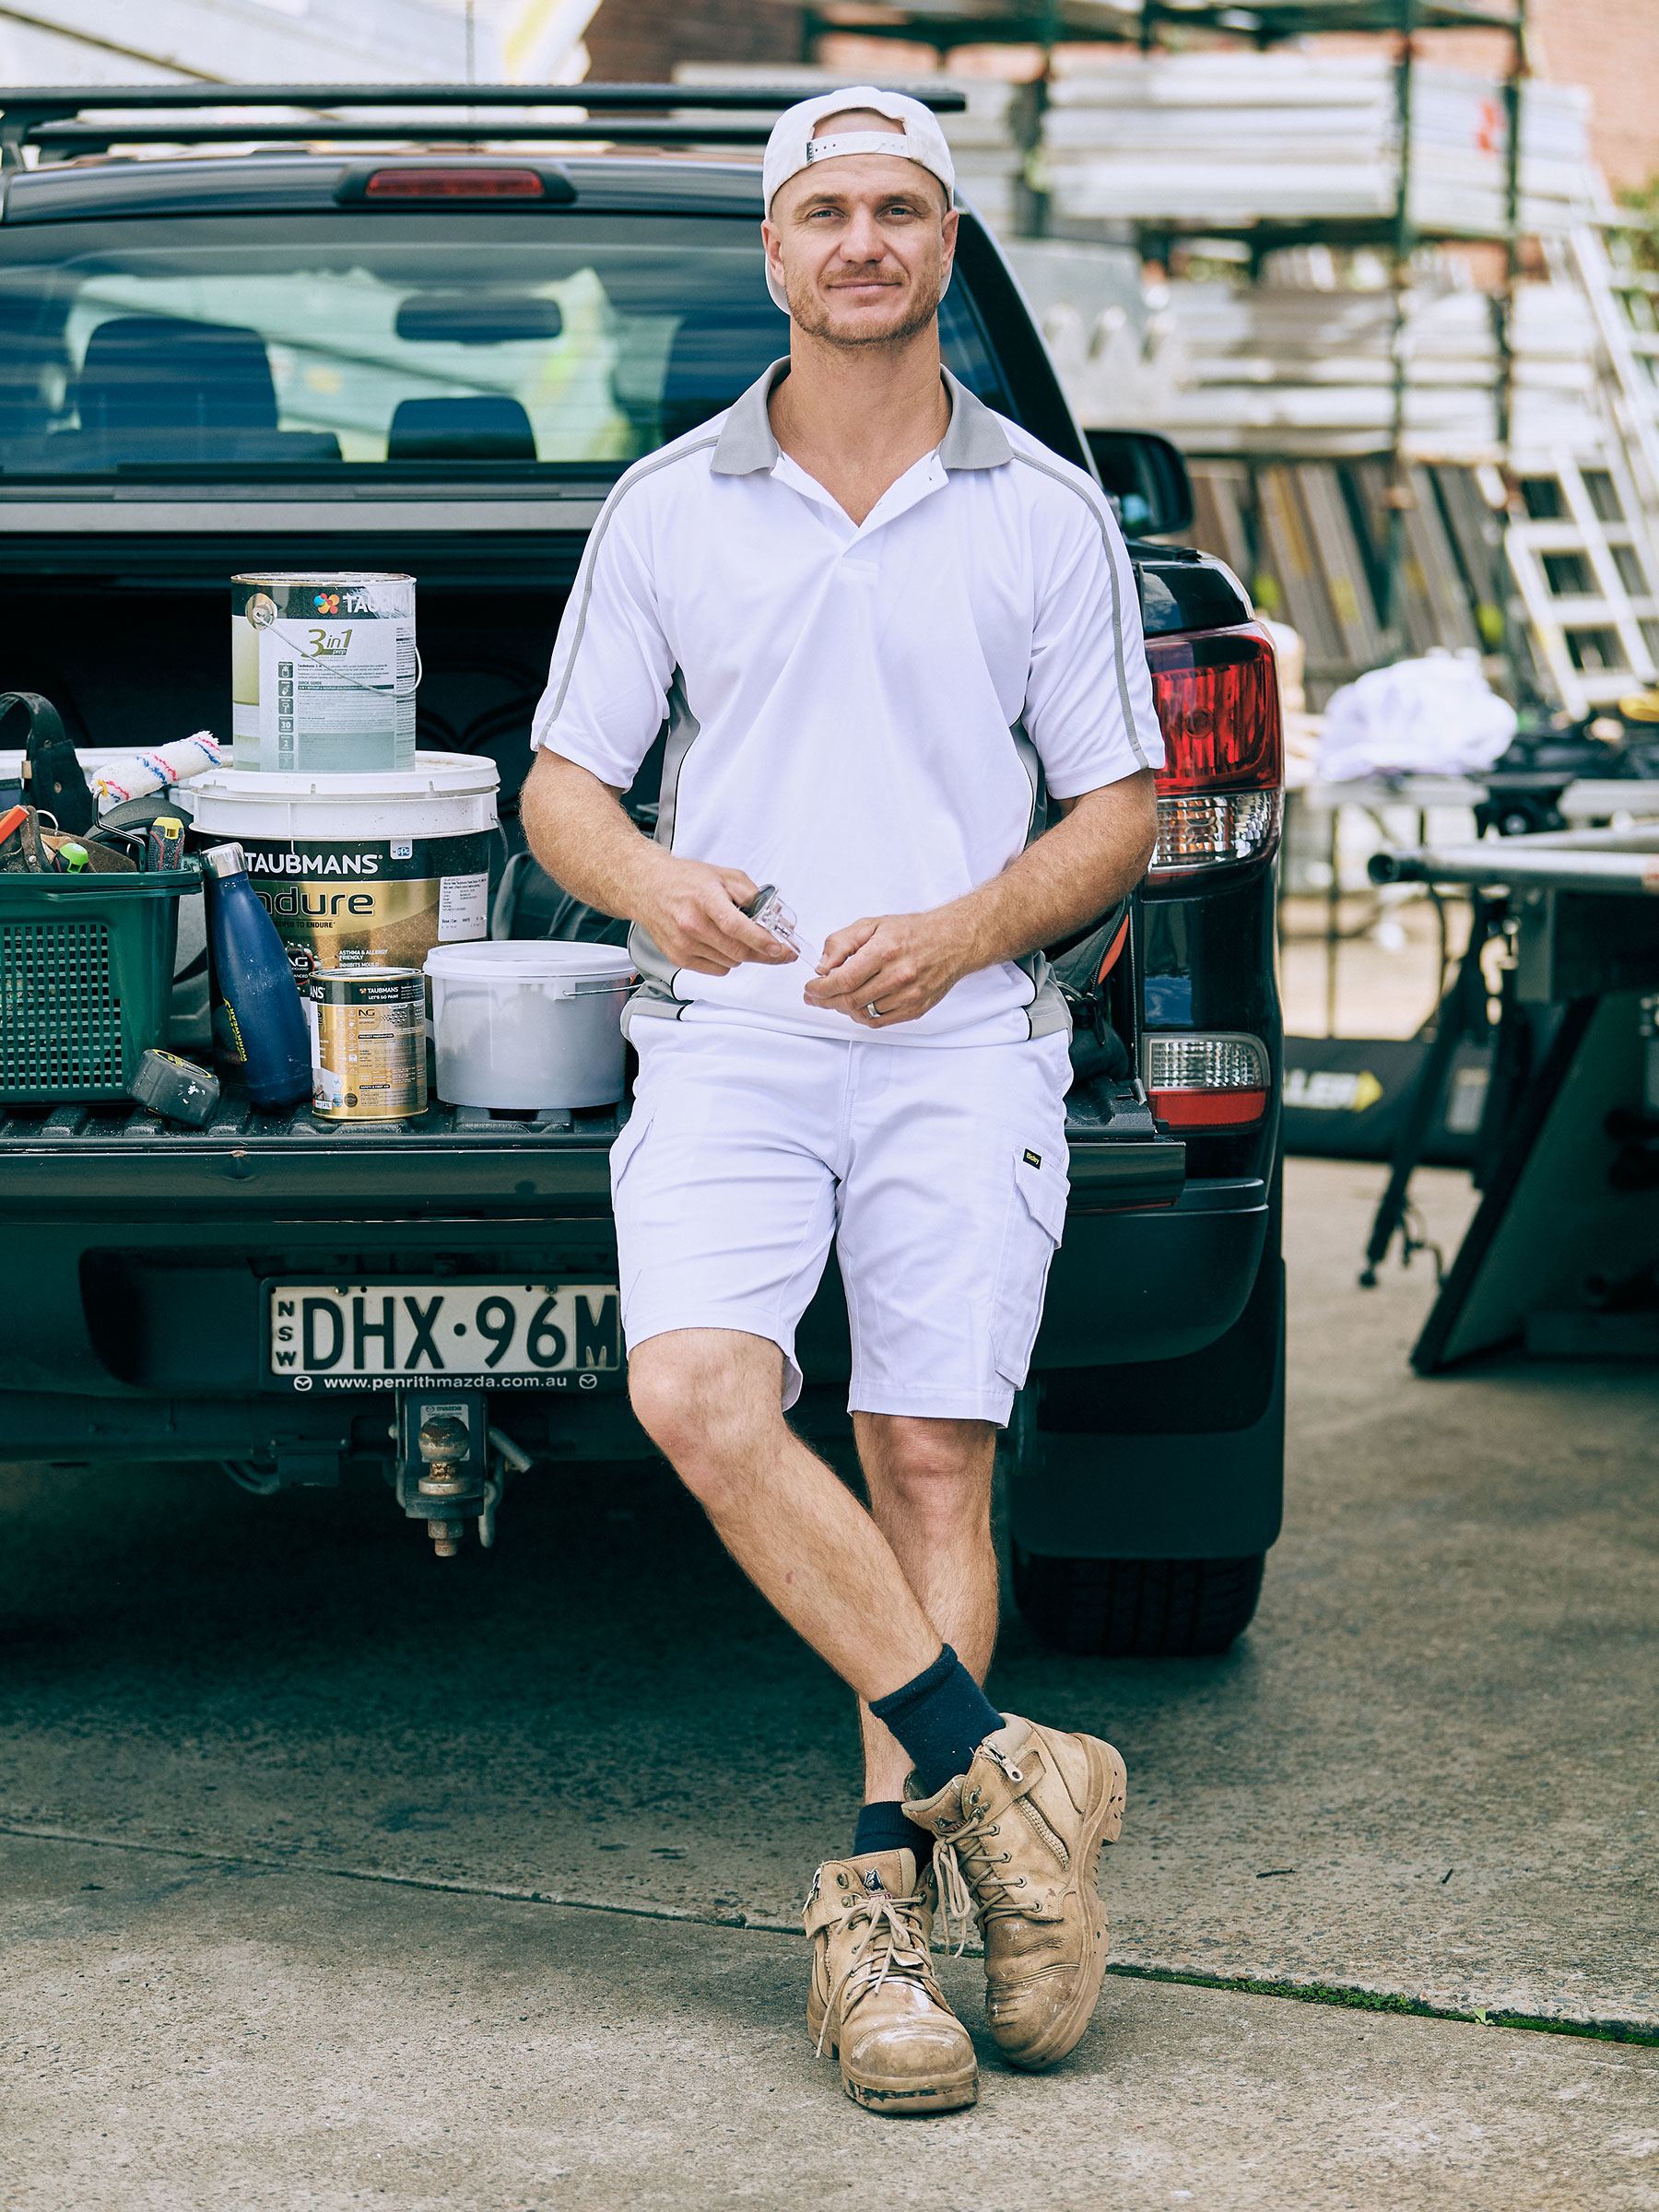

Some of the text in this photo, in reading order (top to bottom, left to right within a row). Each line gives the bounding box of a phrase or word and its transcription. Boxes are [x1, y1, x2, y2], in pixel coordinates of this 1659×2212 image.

[244, 852, 379, 875] TAUBMANS
[254, 886, 375, 916] ndure
[367, 986, 399, 994] TAUBMANS
[324, 1374, 568, 1391] www.penrithmazda.com.au
